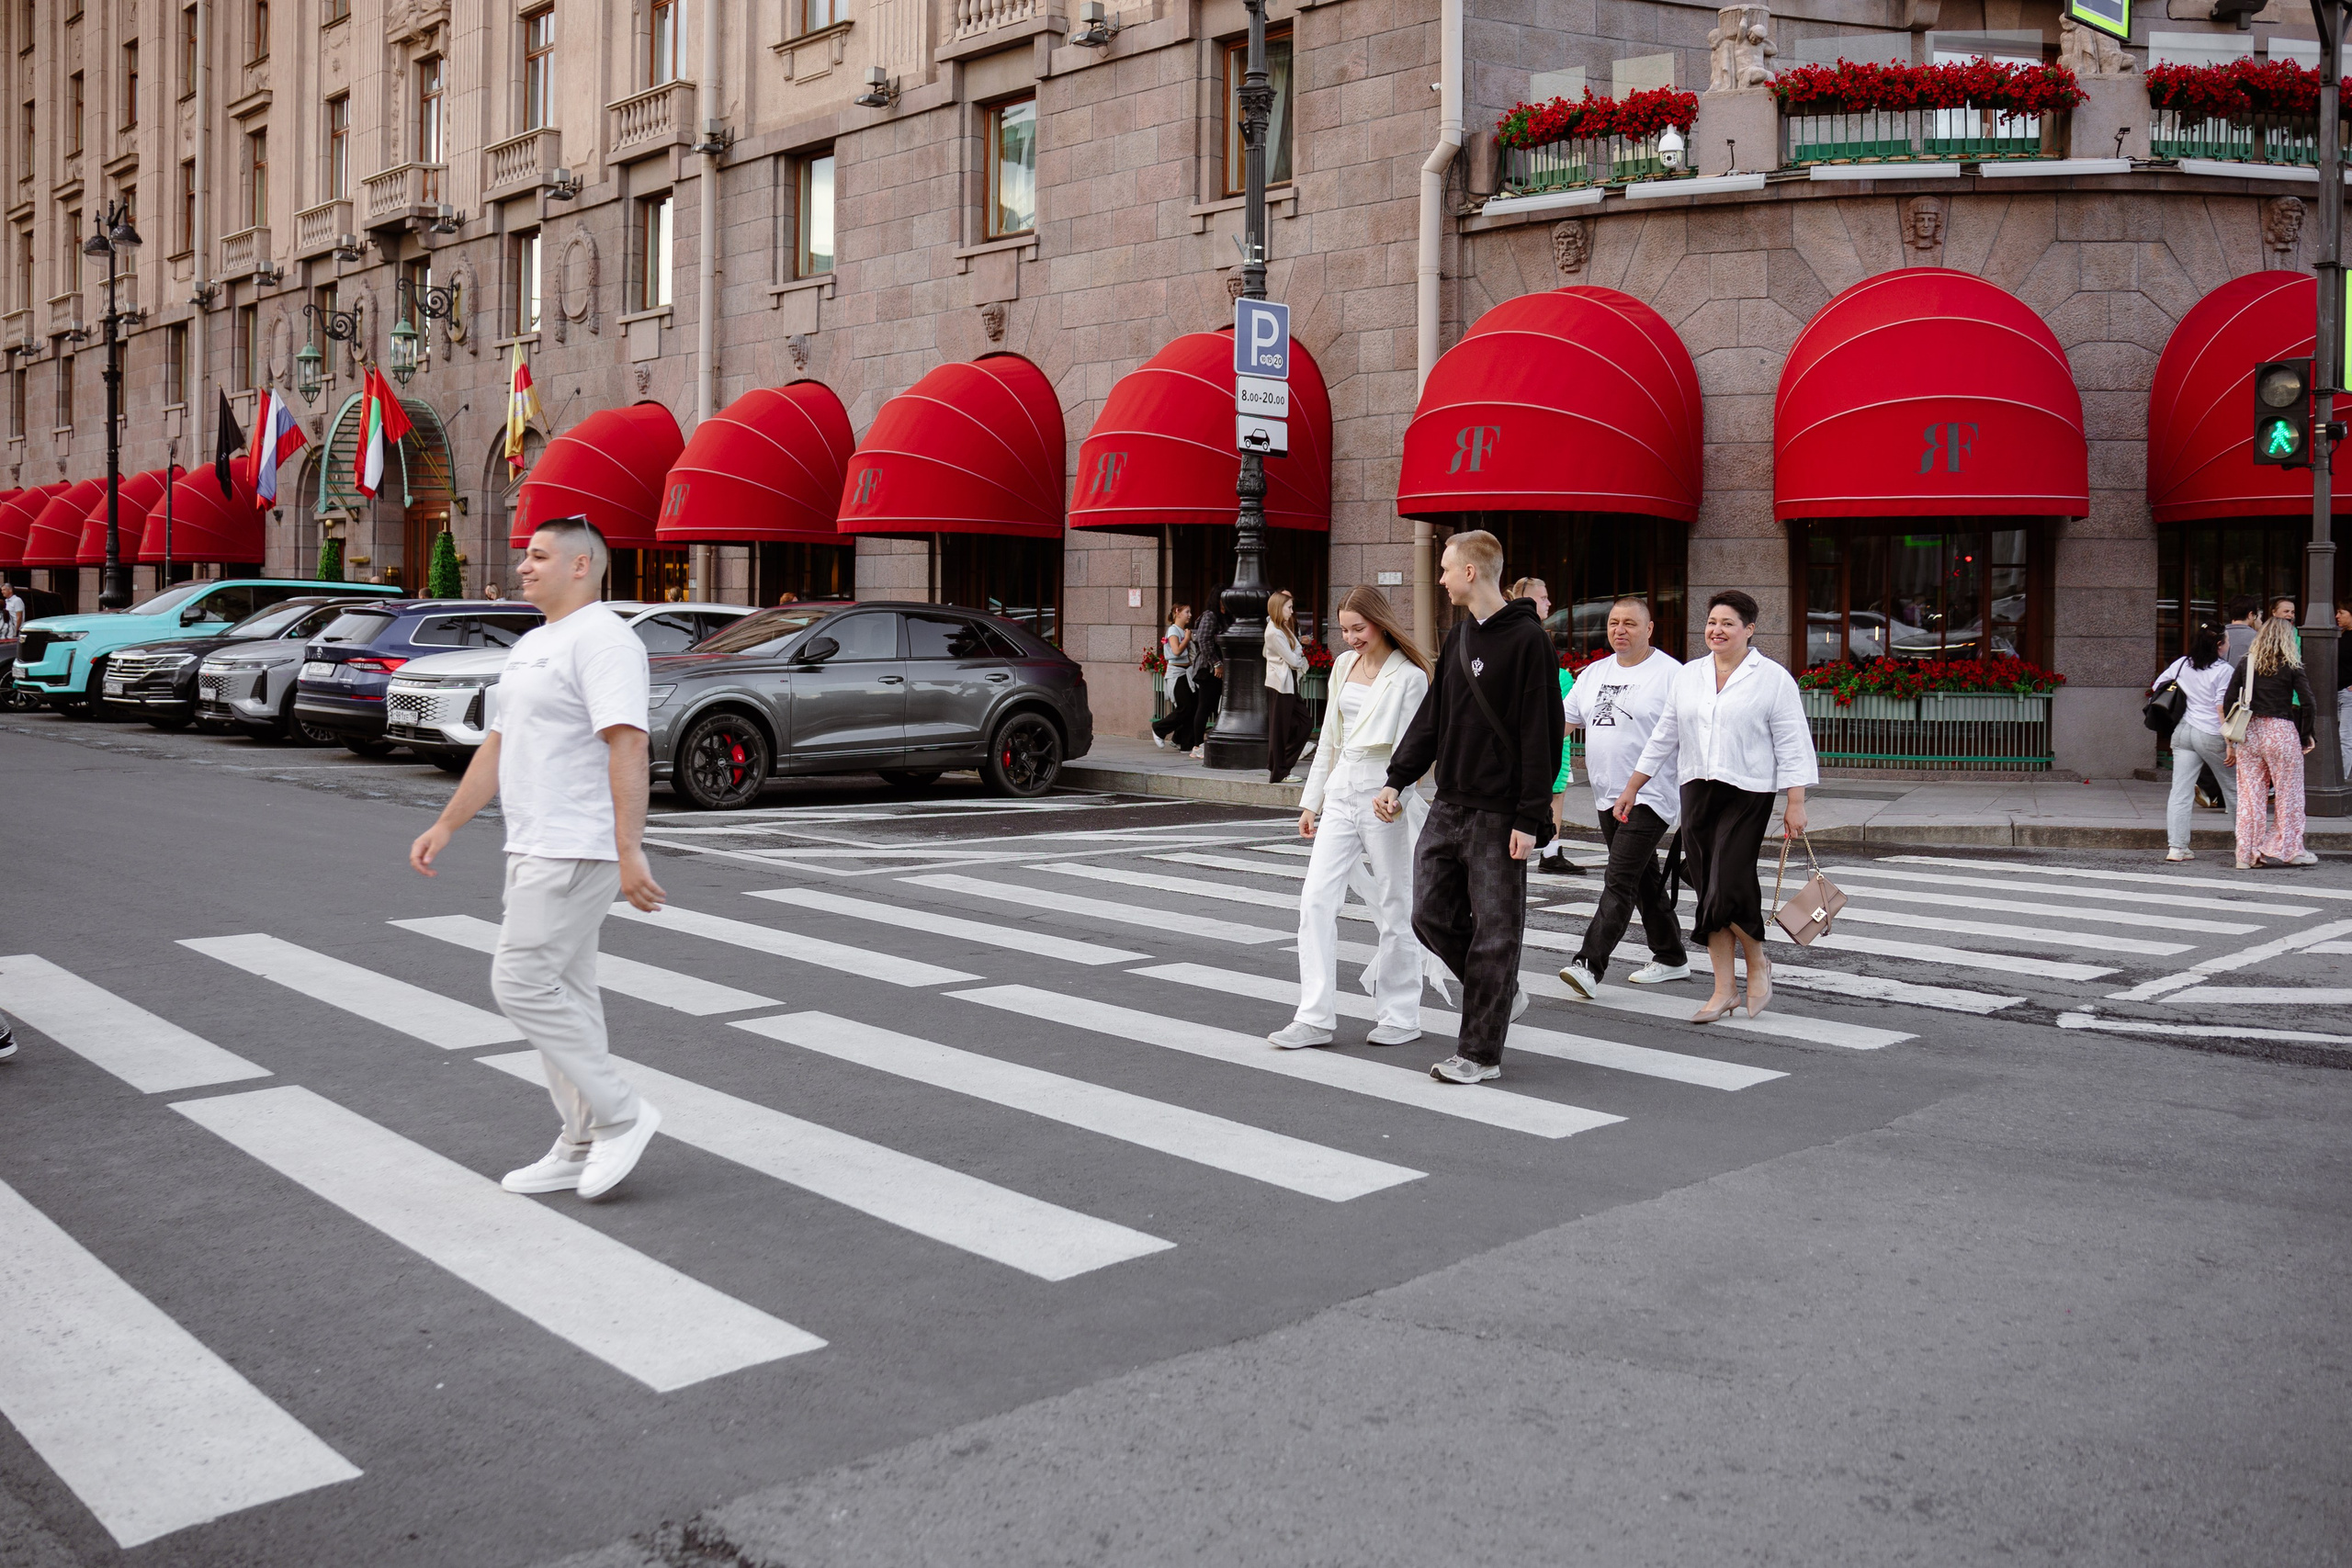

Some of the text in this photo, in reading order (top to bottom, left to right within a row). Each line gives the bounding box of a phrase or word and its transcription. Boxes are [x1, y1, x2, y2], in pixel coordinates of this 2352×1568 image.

[1251, 310, 1280, 367] P
[1274, 355, 1283, 366] 20
[1241, 389, 1285, 405] 8.00-20.00
